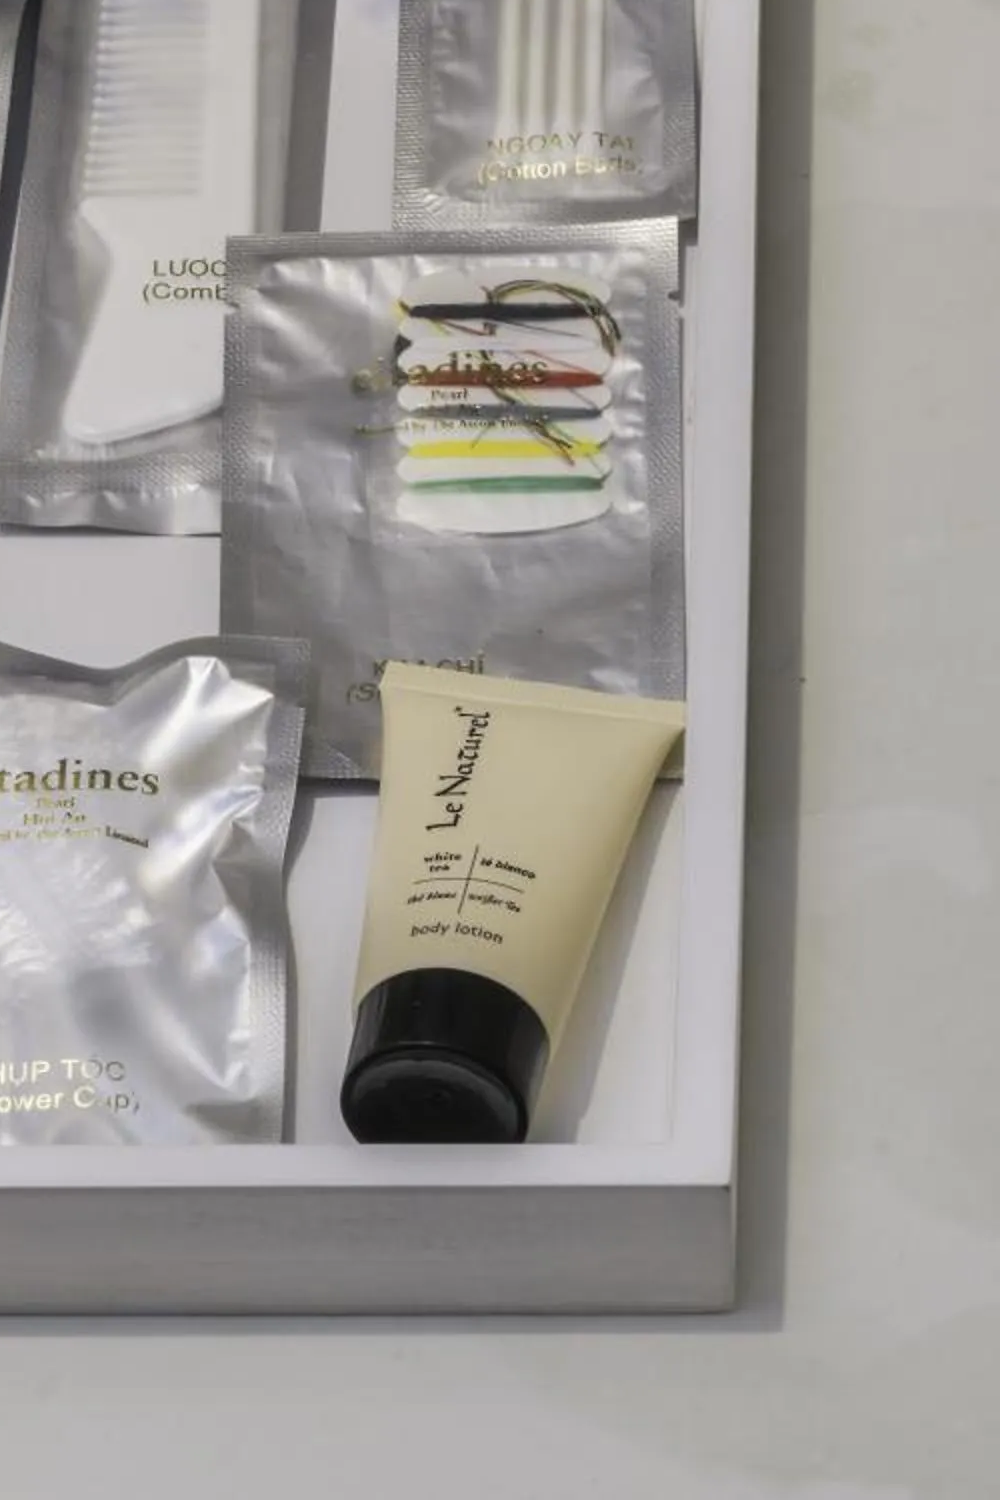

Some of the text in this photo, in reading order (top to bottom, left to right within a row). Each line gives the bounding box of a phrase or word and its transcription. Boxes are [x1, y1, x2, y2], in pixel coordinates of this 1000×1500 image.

[424, 801, 464, 832] Le
[410, 921, 503, 945] body lotion
